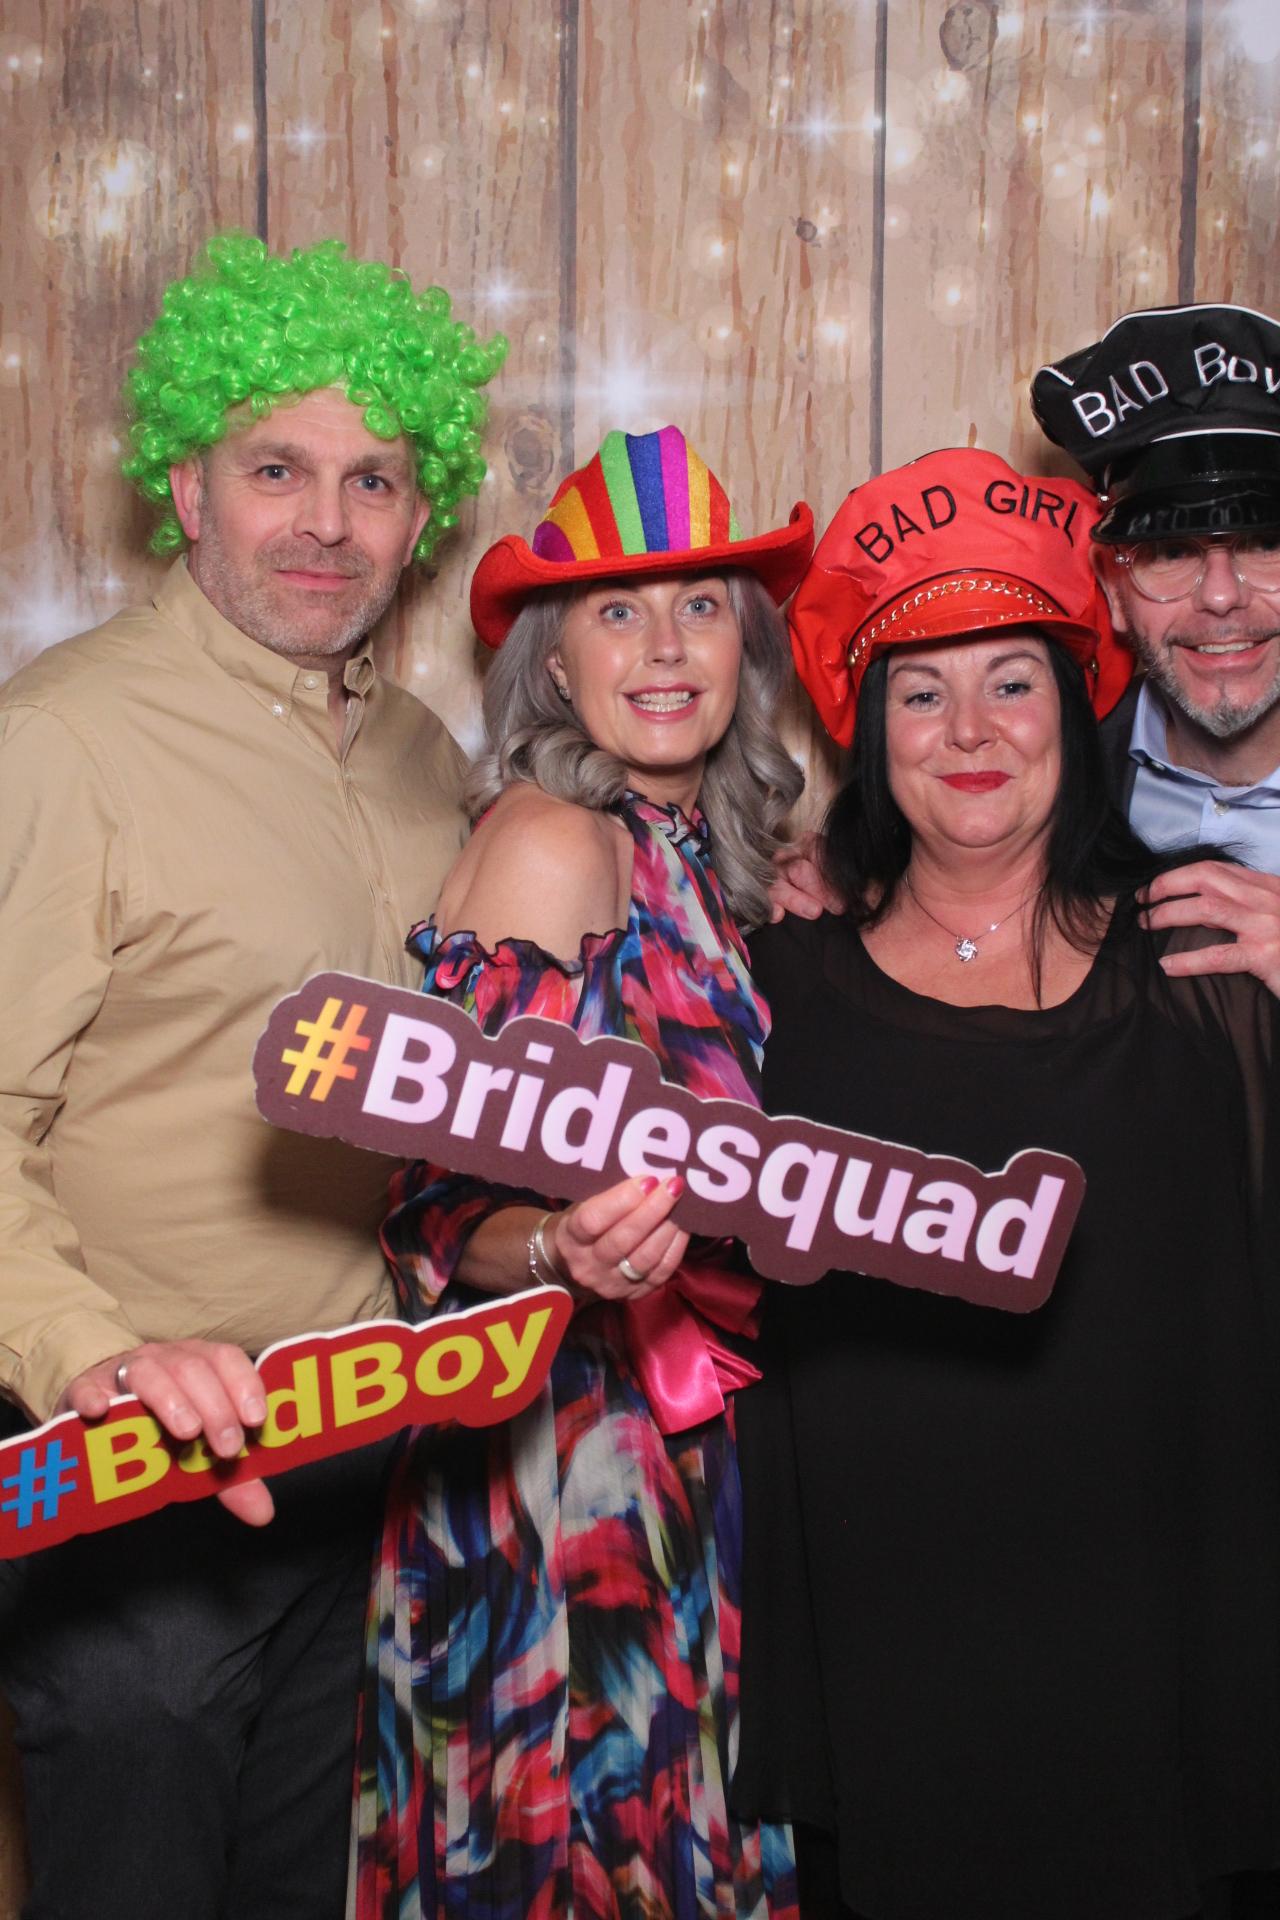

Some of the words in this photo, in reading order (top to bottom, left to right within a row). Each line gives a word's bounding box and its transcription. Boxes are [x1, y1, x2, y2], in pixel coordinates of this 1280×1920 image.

[1072, 361, 1170, 438] BAD
[854, 485, 956, 564] BAD
[984, 480, 1078, 548] GIRL
[281, 997, 1065, 1279] #Bridesquad
[2, 1308, 552, 1528] #BdBoy
